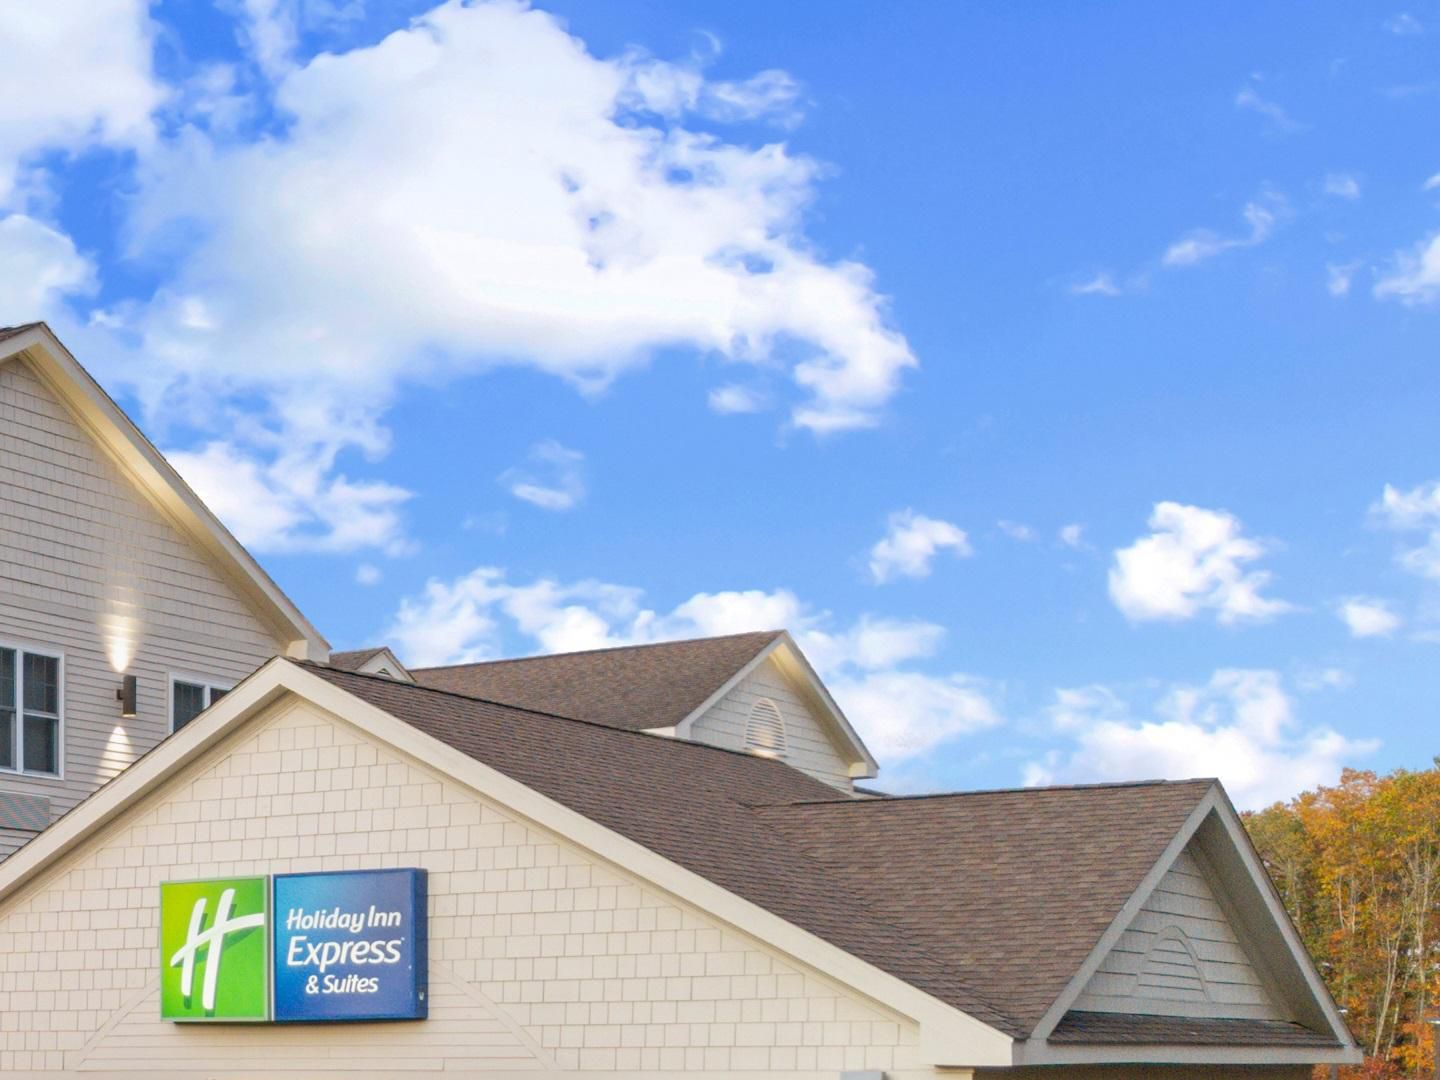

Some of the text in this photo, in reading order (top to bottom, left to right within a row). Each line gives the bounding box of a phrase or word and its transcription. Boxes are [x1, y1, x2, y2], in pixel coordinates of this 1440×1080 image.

[286, 905, 401, 933] Holiday Inn
[287, 936, 401, 973] Express
[305, 974, 379, 994] & Suites
